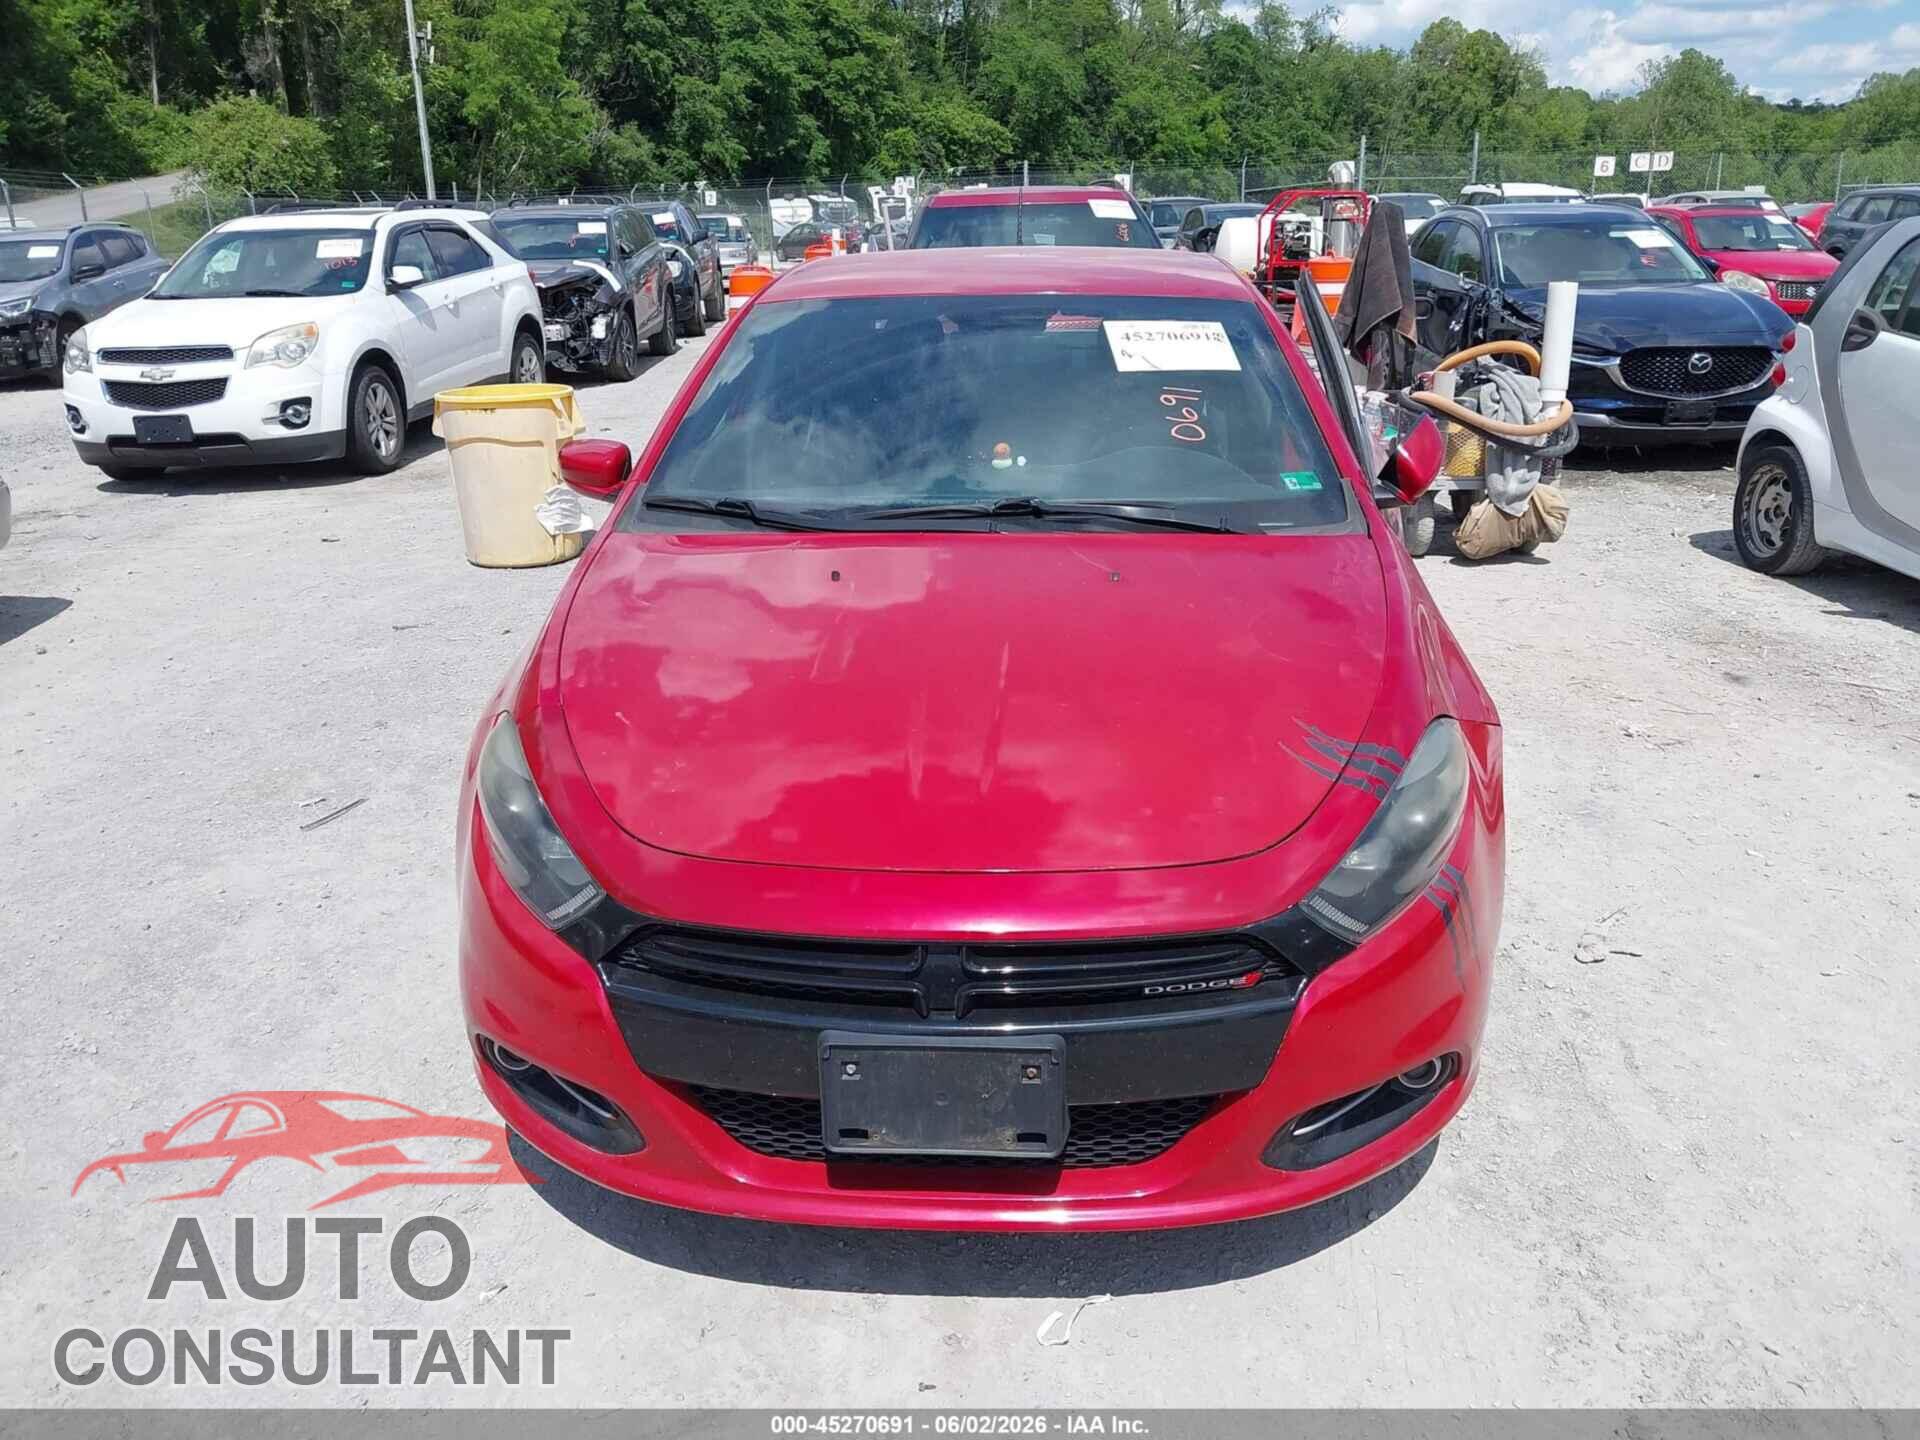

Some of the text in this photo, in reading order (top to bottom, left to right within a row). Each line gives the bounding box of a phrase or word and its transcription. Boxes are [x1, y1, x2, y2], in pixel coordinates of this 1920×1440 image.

[1599, 160, 1610, 173] 6
[1634, 154, 1670, 169] C D
[1159, 386, 1206, 442] 0691
[1144, 977, 1246, 995] DODGE
